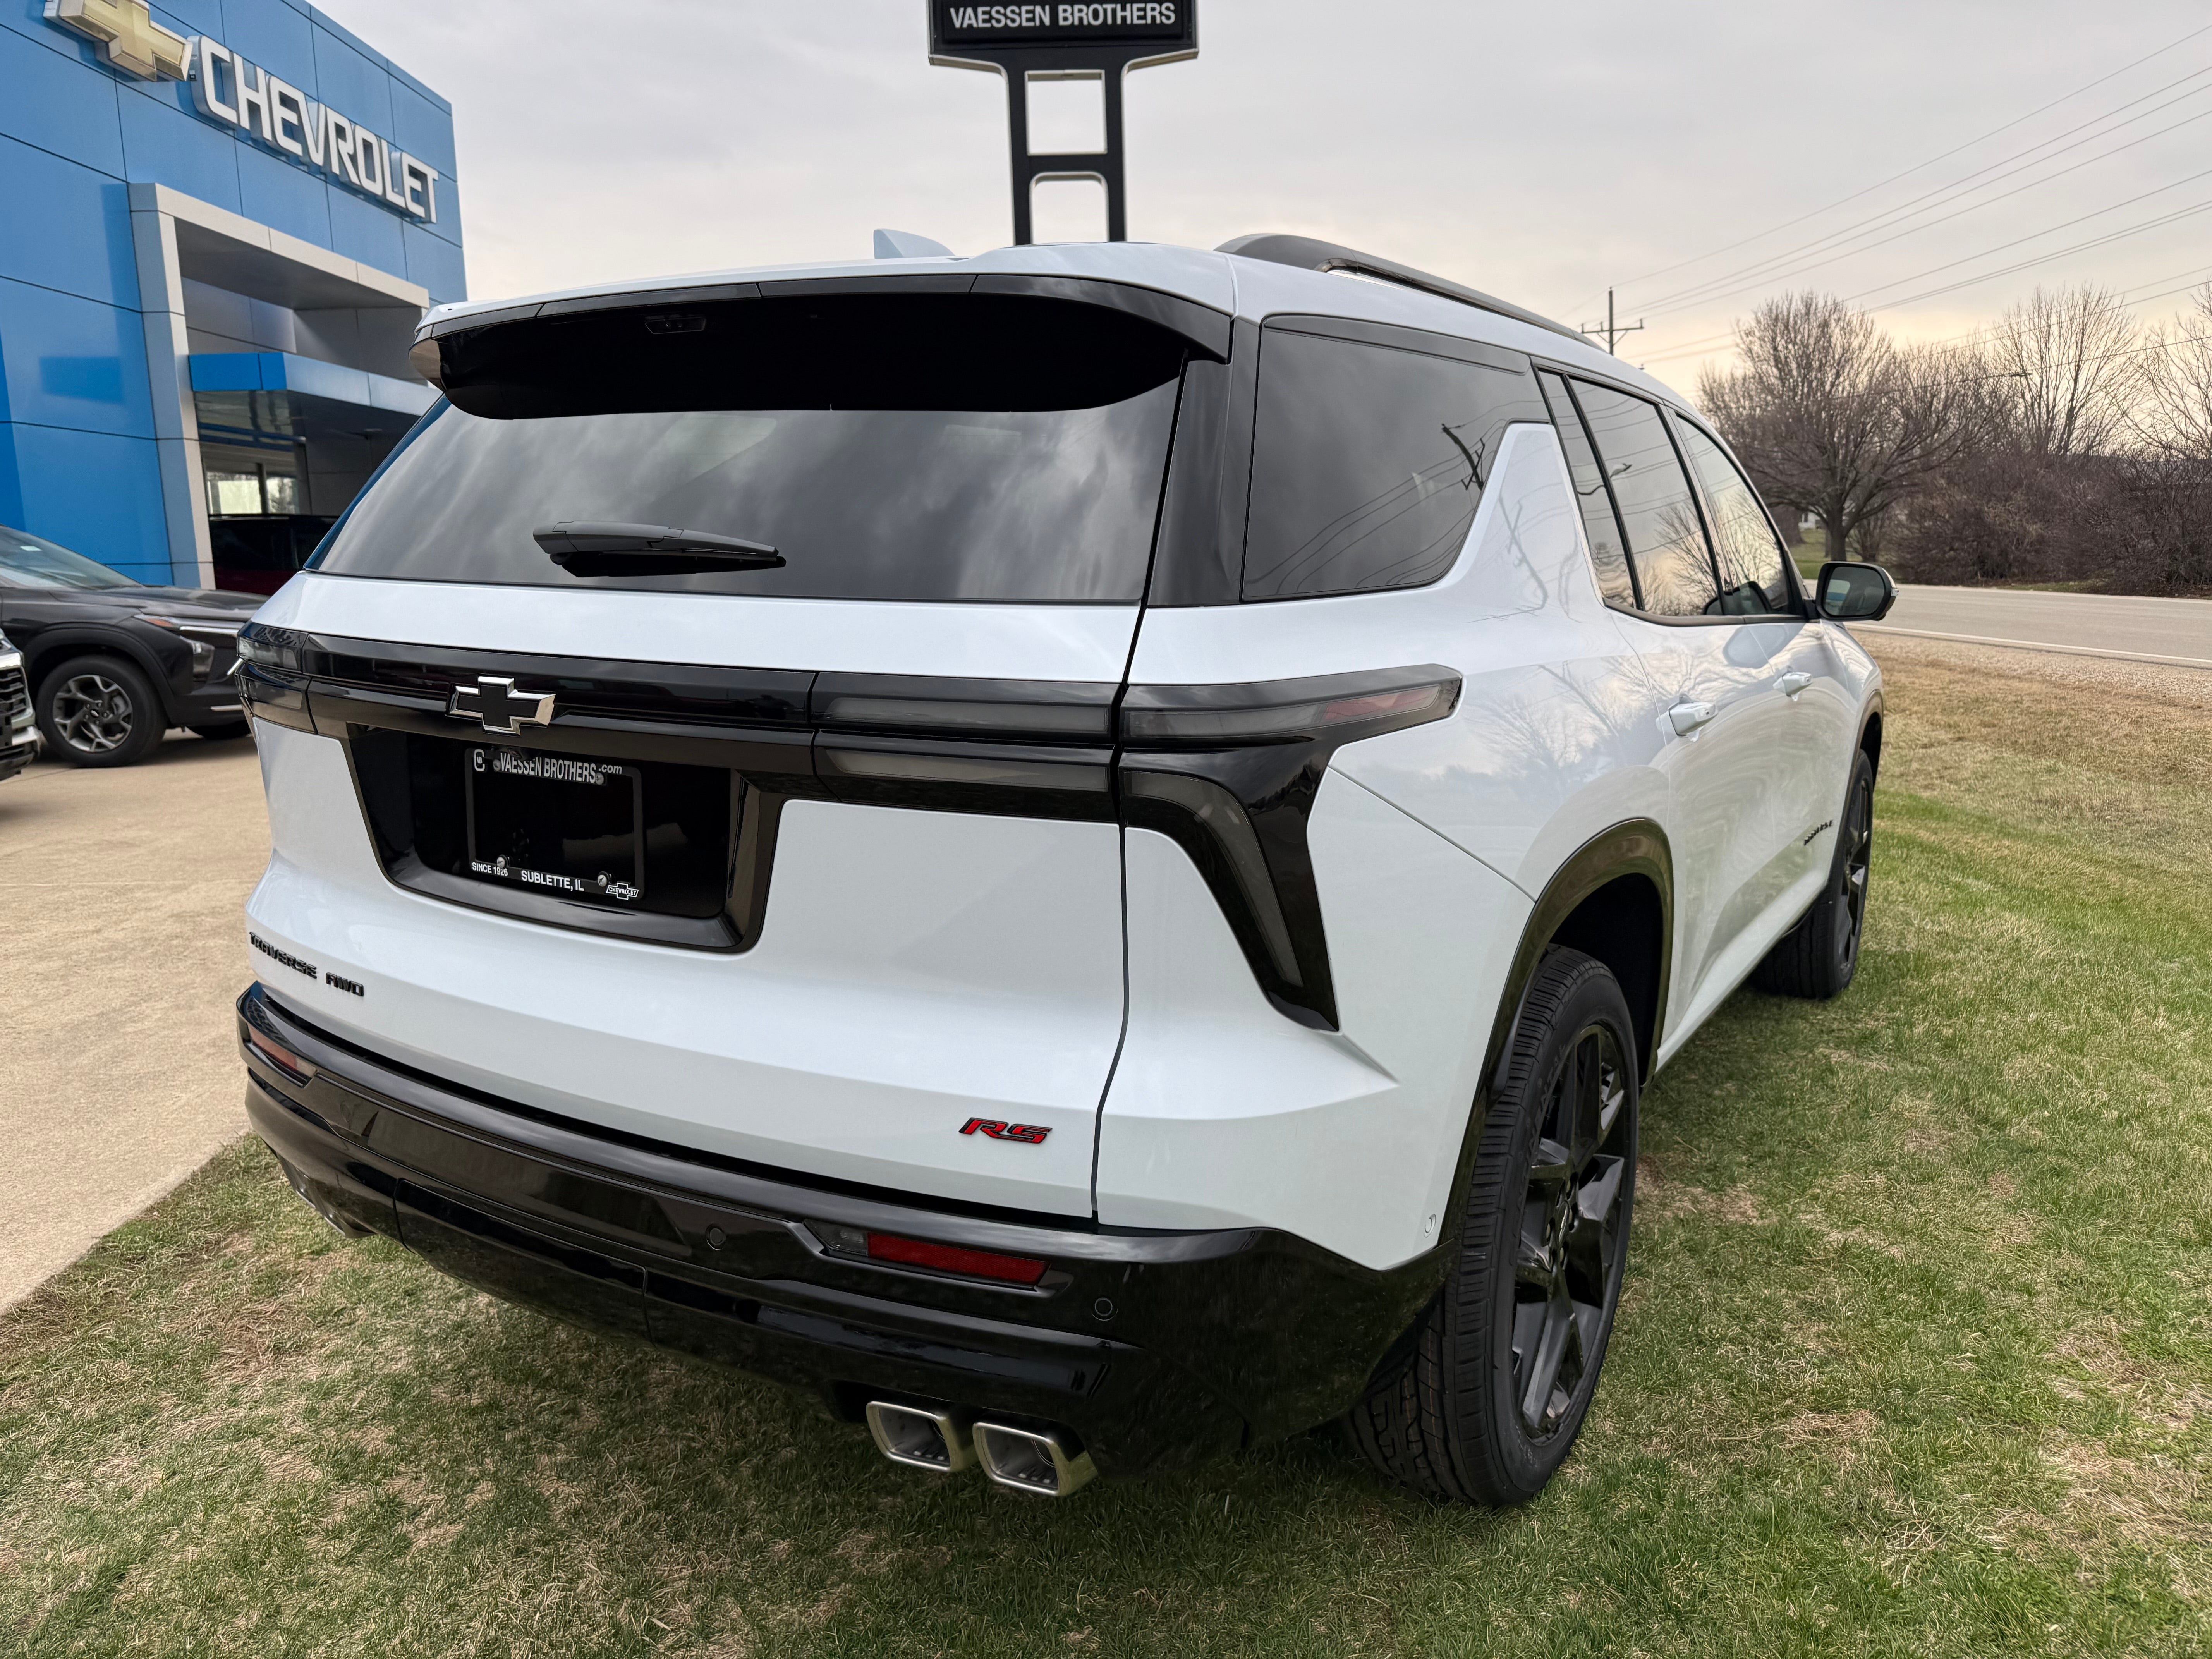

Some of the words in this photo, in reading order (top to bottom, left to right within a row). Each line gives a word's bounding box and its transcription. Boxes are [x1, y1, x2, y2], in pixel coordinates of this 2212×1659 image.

[950, 5, 1050, 29] VAESSEN
[1058, 2, 1176, 26] BROTHERS
[196, 35, 439, 223] CHEVROLET
[500, 752, 542, 776] VAESSEN
[472, 862, 492, 874] SINCE
[493, 866, 508, 877] 1926
[521, 870, 573, 891] SUBLETTE,
[575, 879, 584, 891] IL
[609, 886, 637, 896] CHEVROLET
[249, 931, 318, 979] TRAVERSE
[325, 972, 364, 997] AWD
[958, 1117, 1053, 1144] RS
